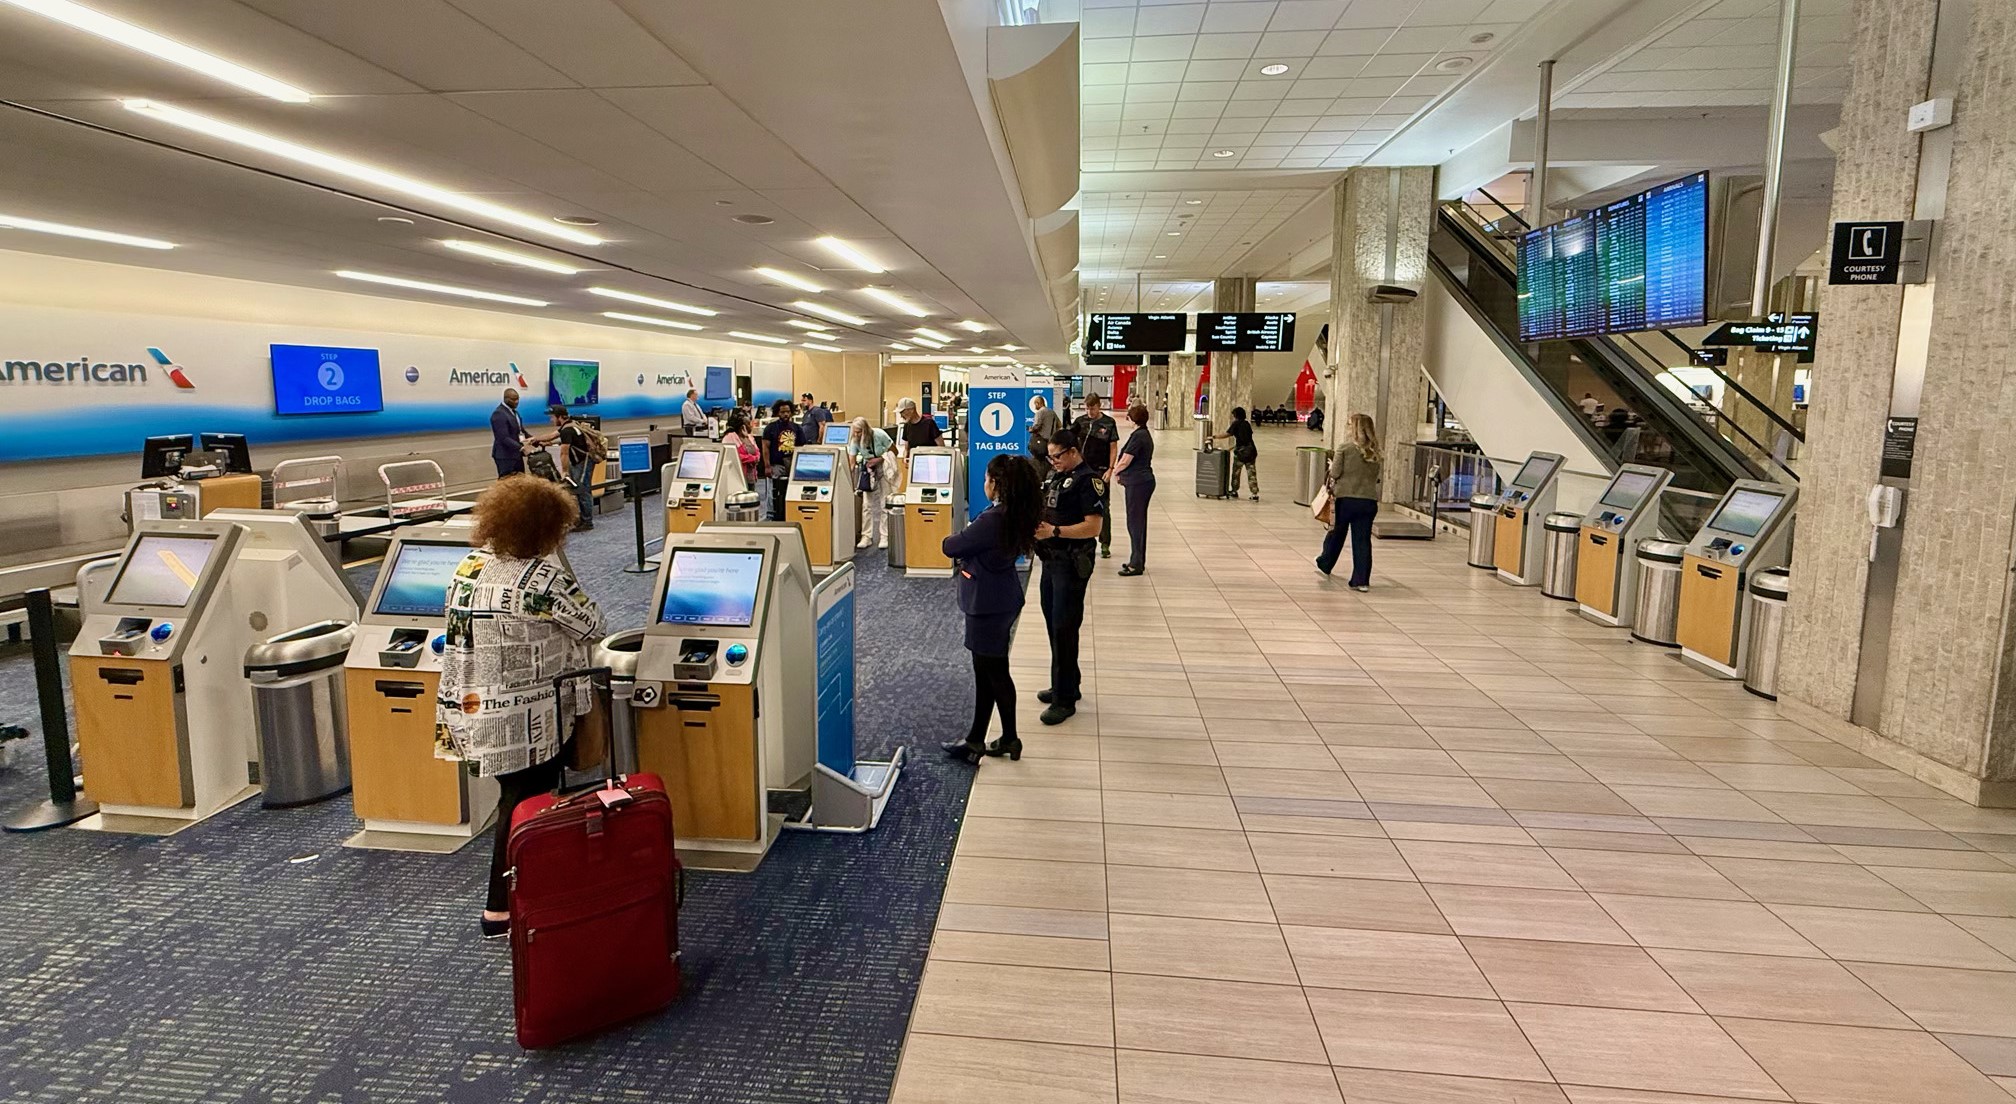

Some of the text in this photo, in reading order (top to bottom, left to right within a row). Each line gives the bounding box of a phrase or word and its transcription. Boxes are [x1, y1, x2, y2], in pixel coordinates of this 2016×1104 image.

[1843, 265, 1886, 273] COURTESY
[1730, 326, 1745, 335] Bag
[1745, 326, 1765, 334] Claim
[1765, 326, 1771, 334] 9
[1751, 335, 1784, 343] Ticketing
[320, 353, 338, 361] STEP
[0, 356, 148, 383] merican
[325, 366, 338, 386] 2
[449, 368, 510, 384] American
[656, 373, 686, 385] American
[304, 395, 361, 406] DROP BAGS
[987, 391, 1007, 399] STEP
[991, 409, 1000, 431] 1
[975, 442, 1020, 451] TAG BAGS
[481, 688, 556, 711] The Fashio
